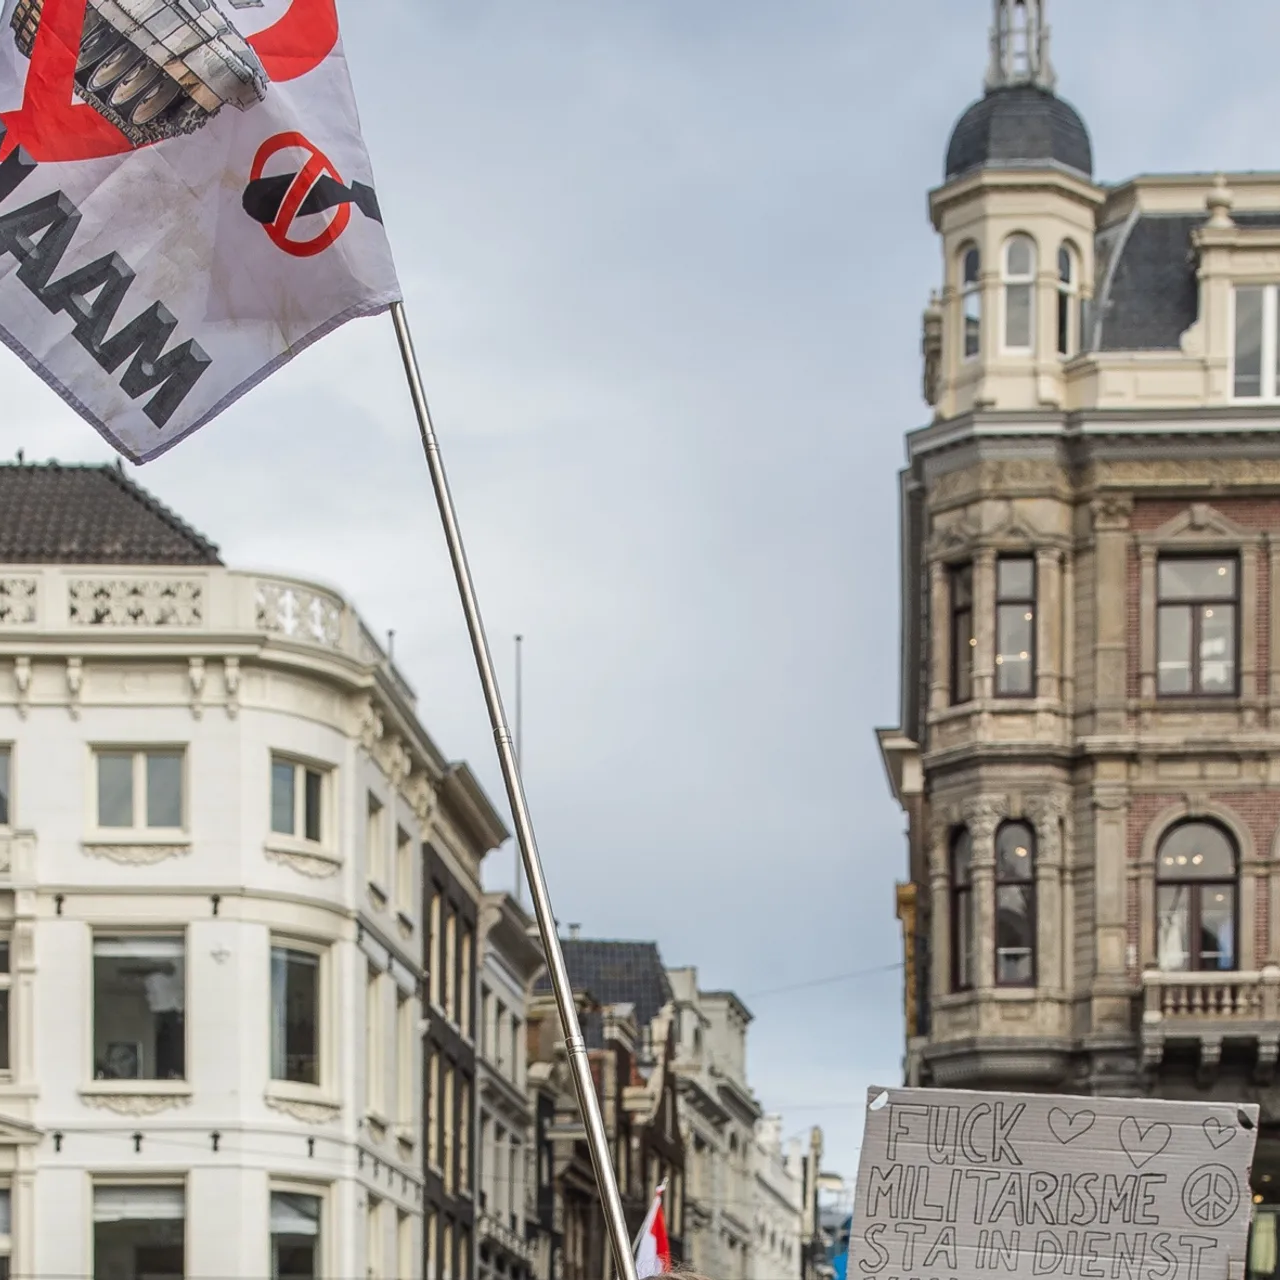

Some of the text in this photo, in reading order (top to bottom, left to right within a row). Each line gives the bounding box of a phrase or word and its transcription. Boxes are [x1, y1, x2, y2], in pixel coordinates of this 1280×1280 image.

[886, 1102, 1027, 1165] FUCK
[866, 1164, 1167, 1226] MILITARISME
[858, 1222, 958, 1274] STA
[975, 1229, 1020, 1272] IN
